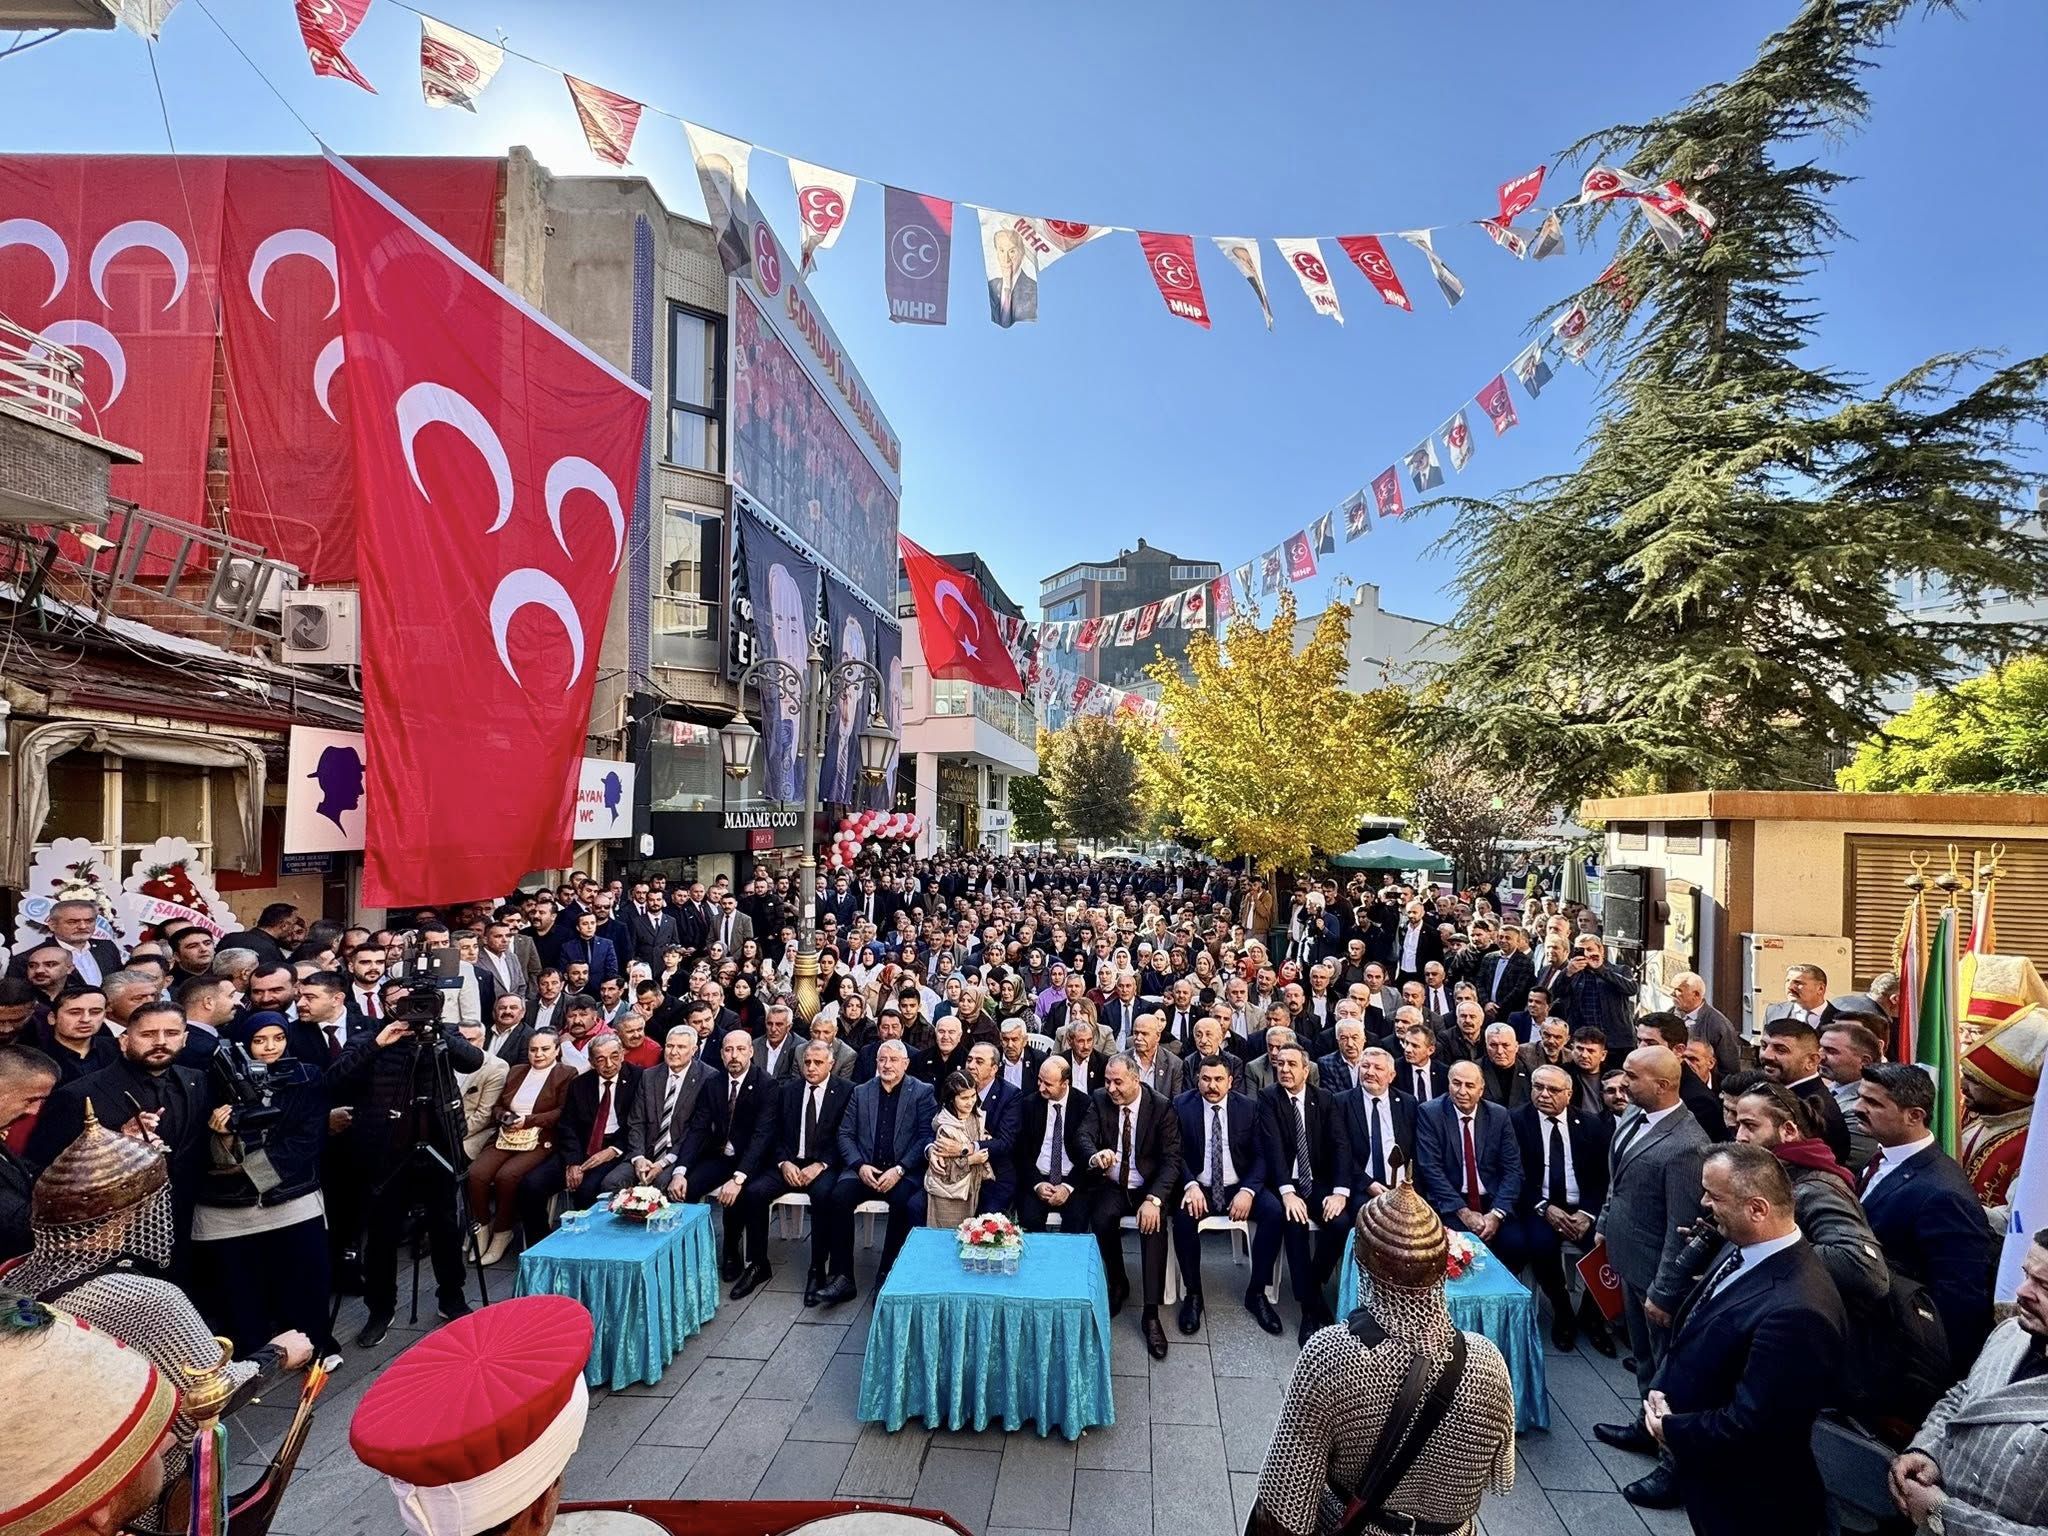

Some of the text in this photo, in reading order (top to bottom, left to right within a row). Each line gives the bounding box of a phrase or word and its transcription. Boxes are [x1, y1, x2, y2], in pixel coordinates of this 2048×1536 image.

[1013, 218, 1050, 254] MHP
[1383, 288, 1407, 308] MHP
[892, 299, 937, 320] MHP
[1170, 299, 1202, 320] MHP
[788, 284, 836, 377] ÇORUM
[1293, 566, 1312, 578] MHP
[578, 789, 602, 803] AYAN
[580, 809, 594, 823] WC
[724, 812, 798, 829] MADAME COCO
